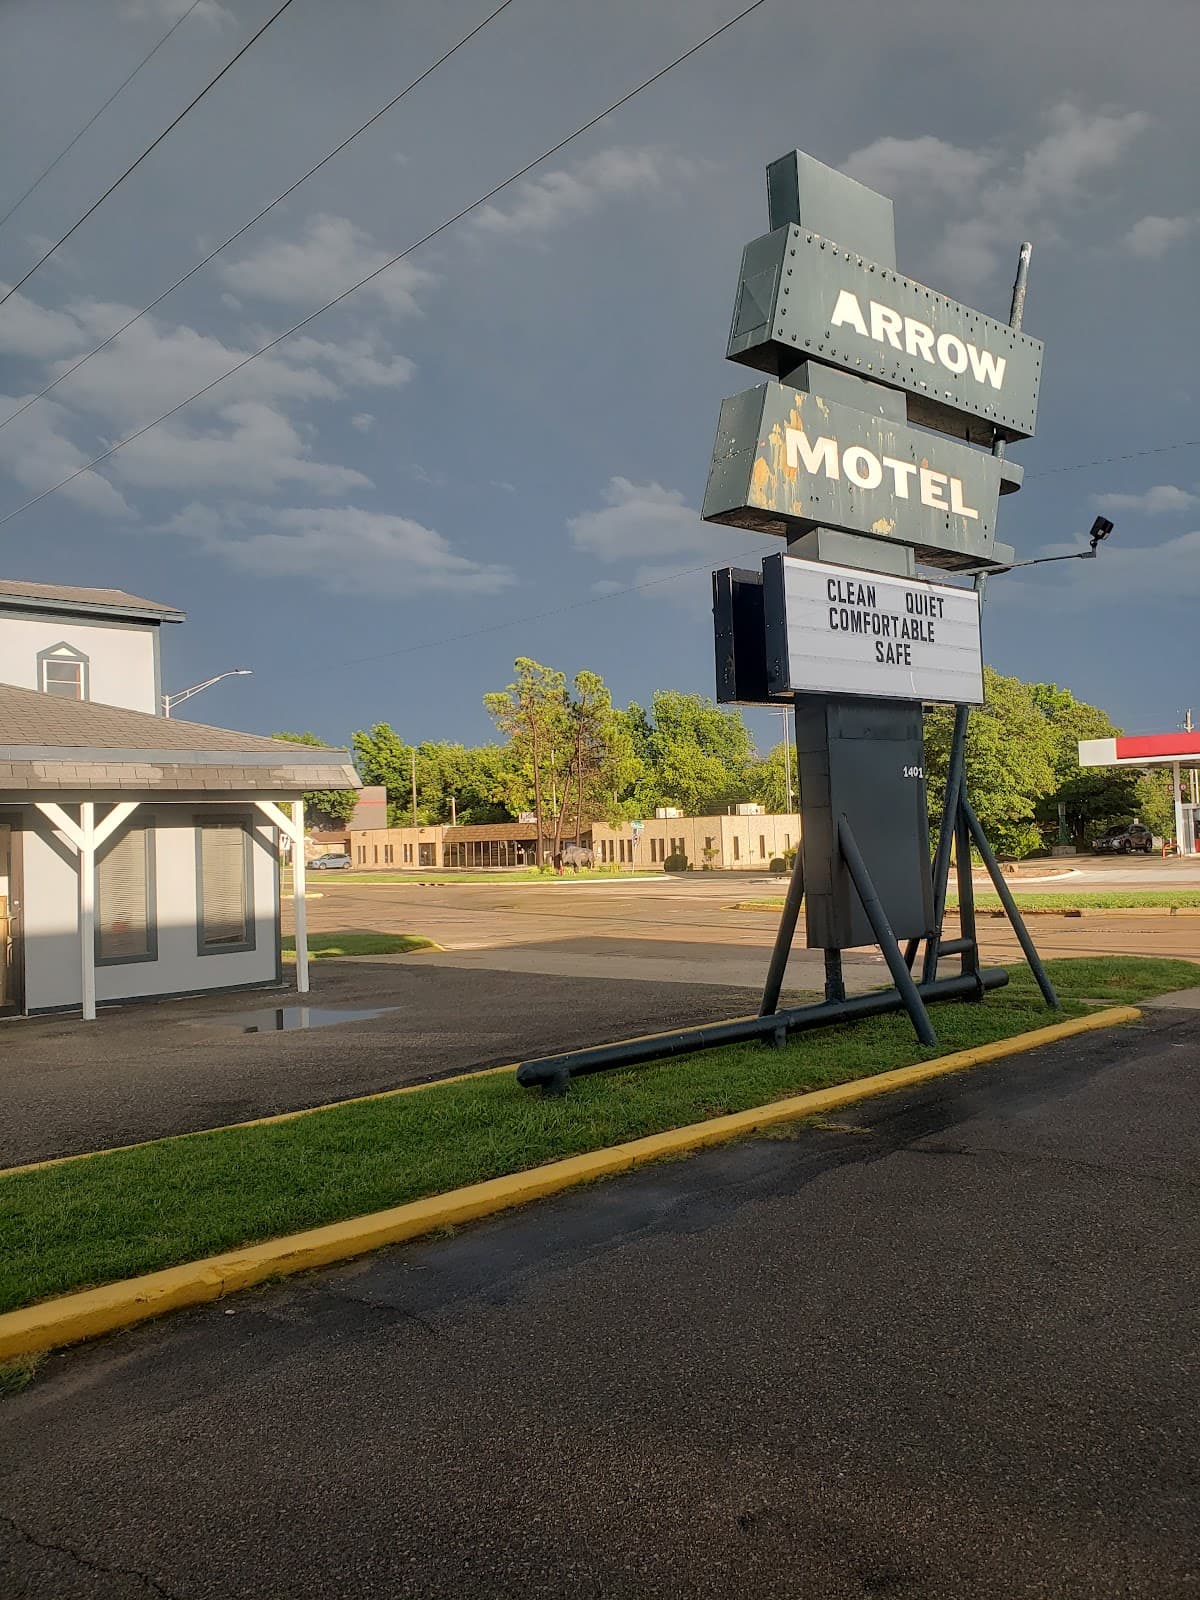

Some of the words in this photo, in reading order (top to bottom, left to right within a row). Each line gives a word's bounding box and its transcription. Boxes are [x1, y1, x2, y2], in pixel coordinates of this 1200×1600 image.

[830, 289, 1006, 390] ARROW
[784, 427, 979, 520] MOTEL
[827, 578, 876, 608] CLEAN
[905, 592, 944, 618] QUIET
[829, 607, 935, 642] COMFORTABLE
[875, 641, 911, 665] SAFE
[903, 766, 924, 778] 1401
